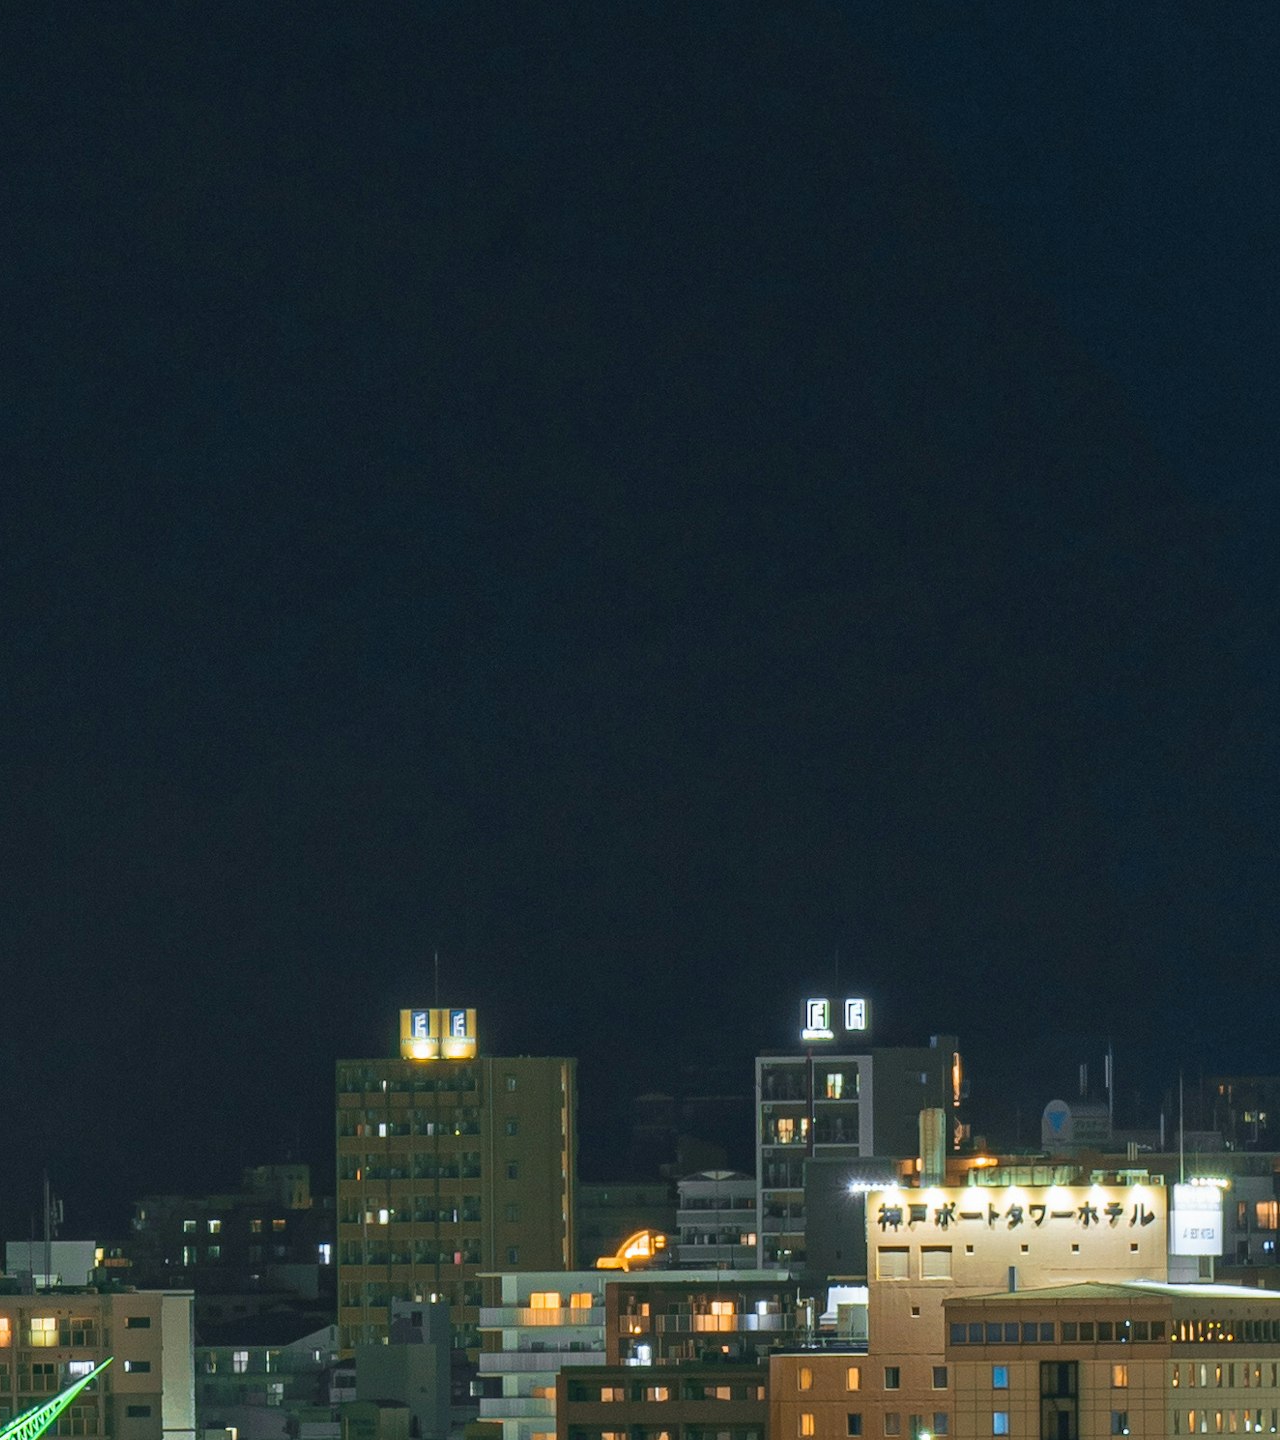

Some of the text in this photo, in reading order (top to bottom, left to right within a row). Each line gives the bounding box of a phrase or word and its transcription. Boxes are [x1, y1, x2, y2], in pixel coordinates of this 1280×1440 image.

[877, 1201, 1156, 1232] 神戸ポートタワーホテル
